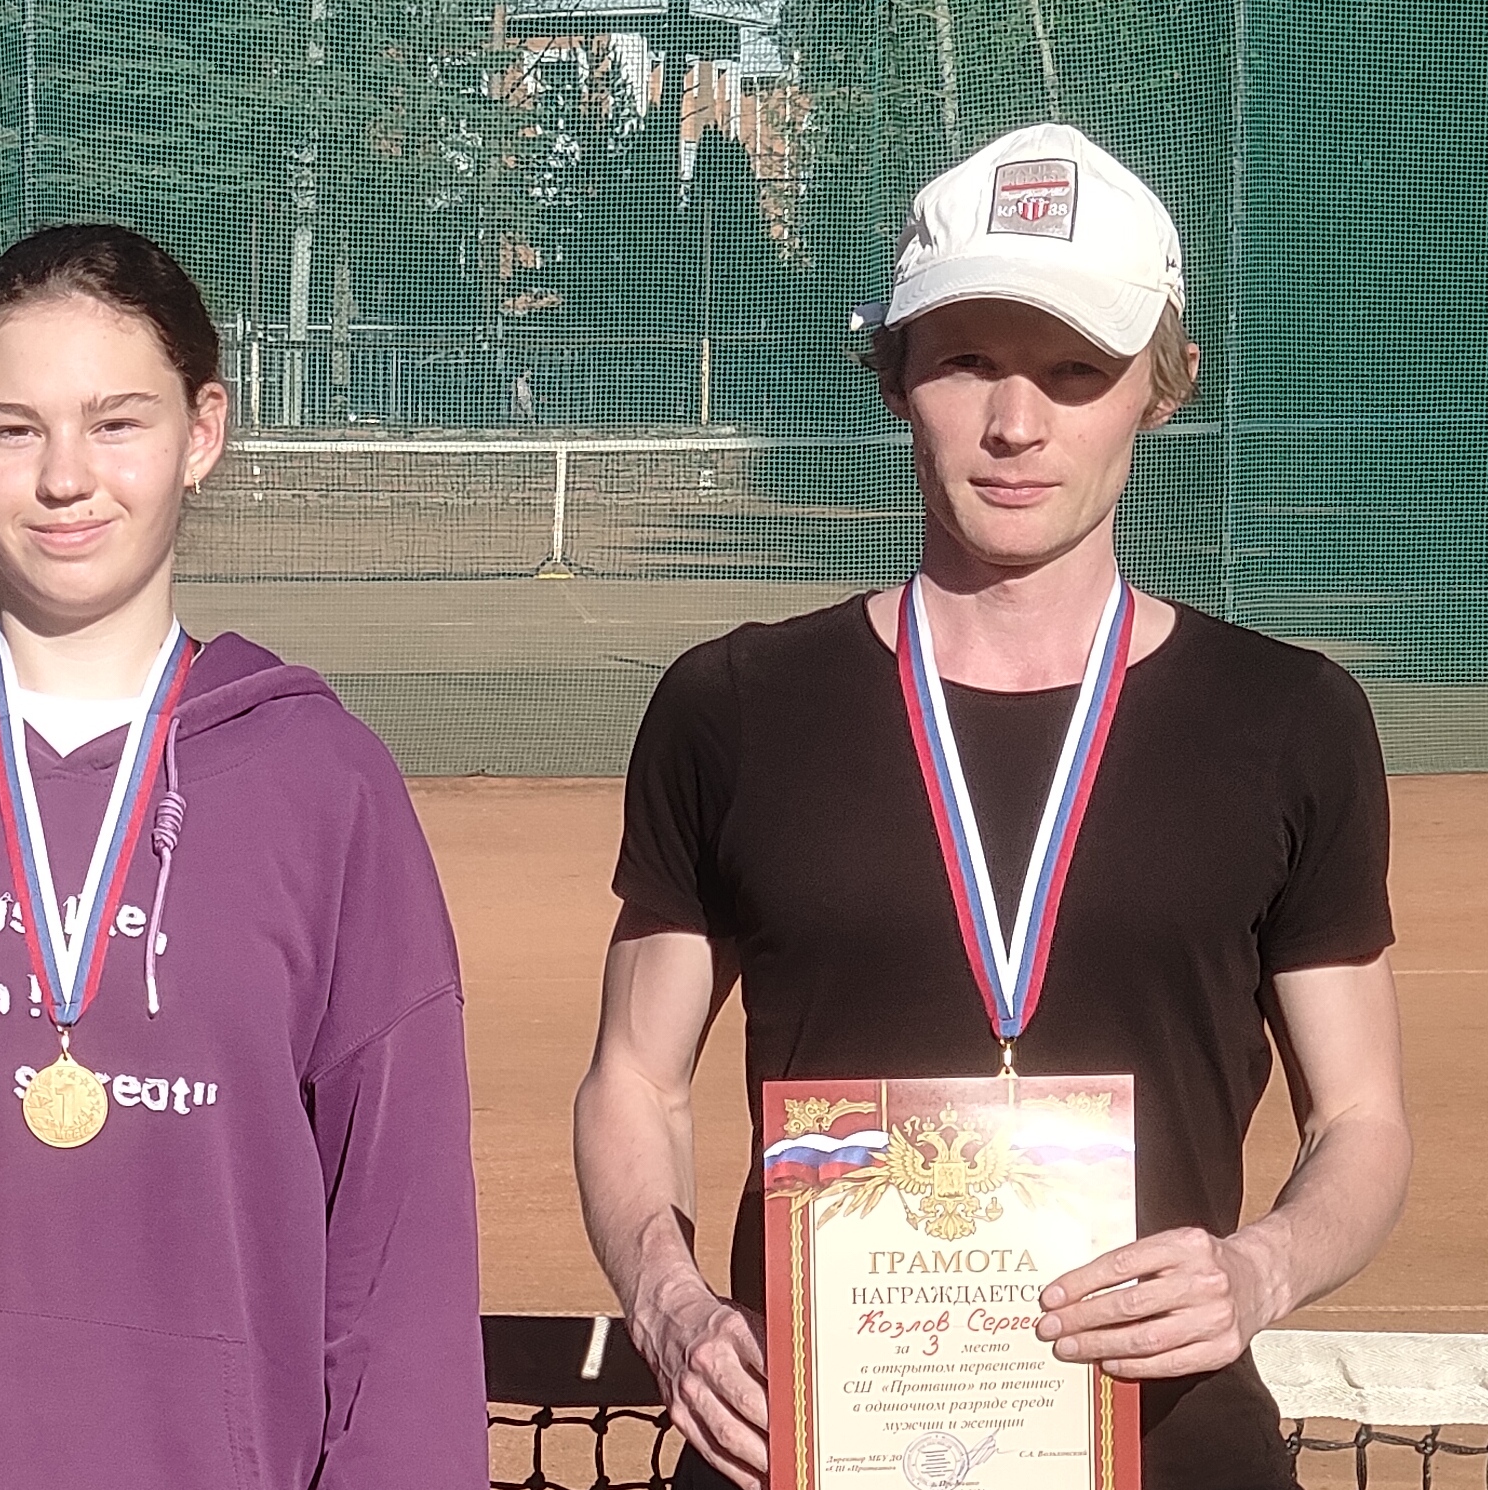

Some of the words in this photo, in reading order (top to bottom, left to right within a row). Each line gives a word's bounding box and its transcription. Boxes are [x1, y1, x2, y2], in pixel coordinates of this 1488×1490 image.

[95, 1071, 218, 1115] eat"
[868, 1249, 1039, 1275] ГРАМОТА
[857, 1309, 950, 1339] Козлов
[894, 1344, 910, 1355] за
[922, 1334, 940, 1356] 3
[960, 1342, 1010, 1354] место
[860, 1364, 869, 1375] в
[872, 1361, 955, 1378] открытом
[959, 1360, 1045, 1375] первенстве
[843, 1380, 873, 1394] СШ
[881, 1379, 975, 1395] «Протвино»
[979, 1381, 997, 1391] по
[1001, 1379, 1065, 1392] теннису
[864, 1399, 946, 1413] одиночном
[948, 1397, 1008, 1414] разряде
[1011, 1395, 1055, 1411] среди
[882, 1420, 944, 1435] мужчин
[948, 1419, 957, 1429] и
[960, 1417, 1025, 1431] женщин
